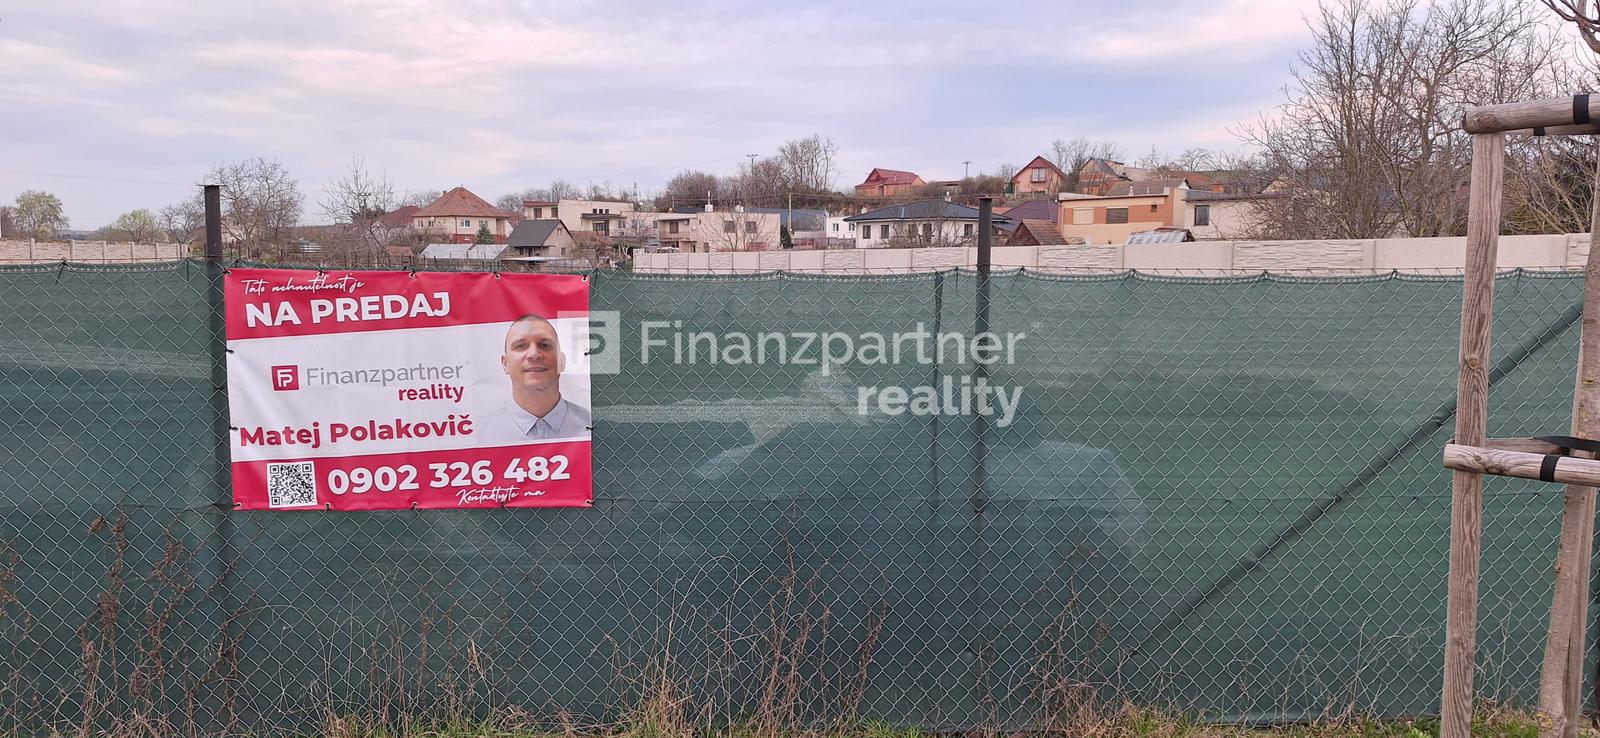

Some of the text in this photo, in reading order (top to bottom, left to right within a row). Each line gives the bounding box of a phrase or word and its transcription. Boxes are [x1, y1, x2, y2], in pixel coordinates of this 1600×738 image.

[348, 279, 365, 293] je
[246, 292, 450, 328] NA PREDAJ
[306, 363, 463, 386] Finanzpartner
[398, 383, 464, 403] reality
[240, 414, 474, 449] Matej Polakovič
[327, 455, 570, 495] 0902 326 482
